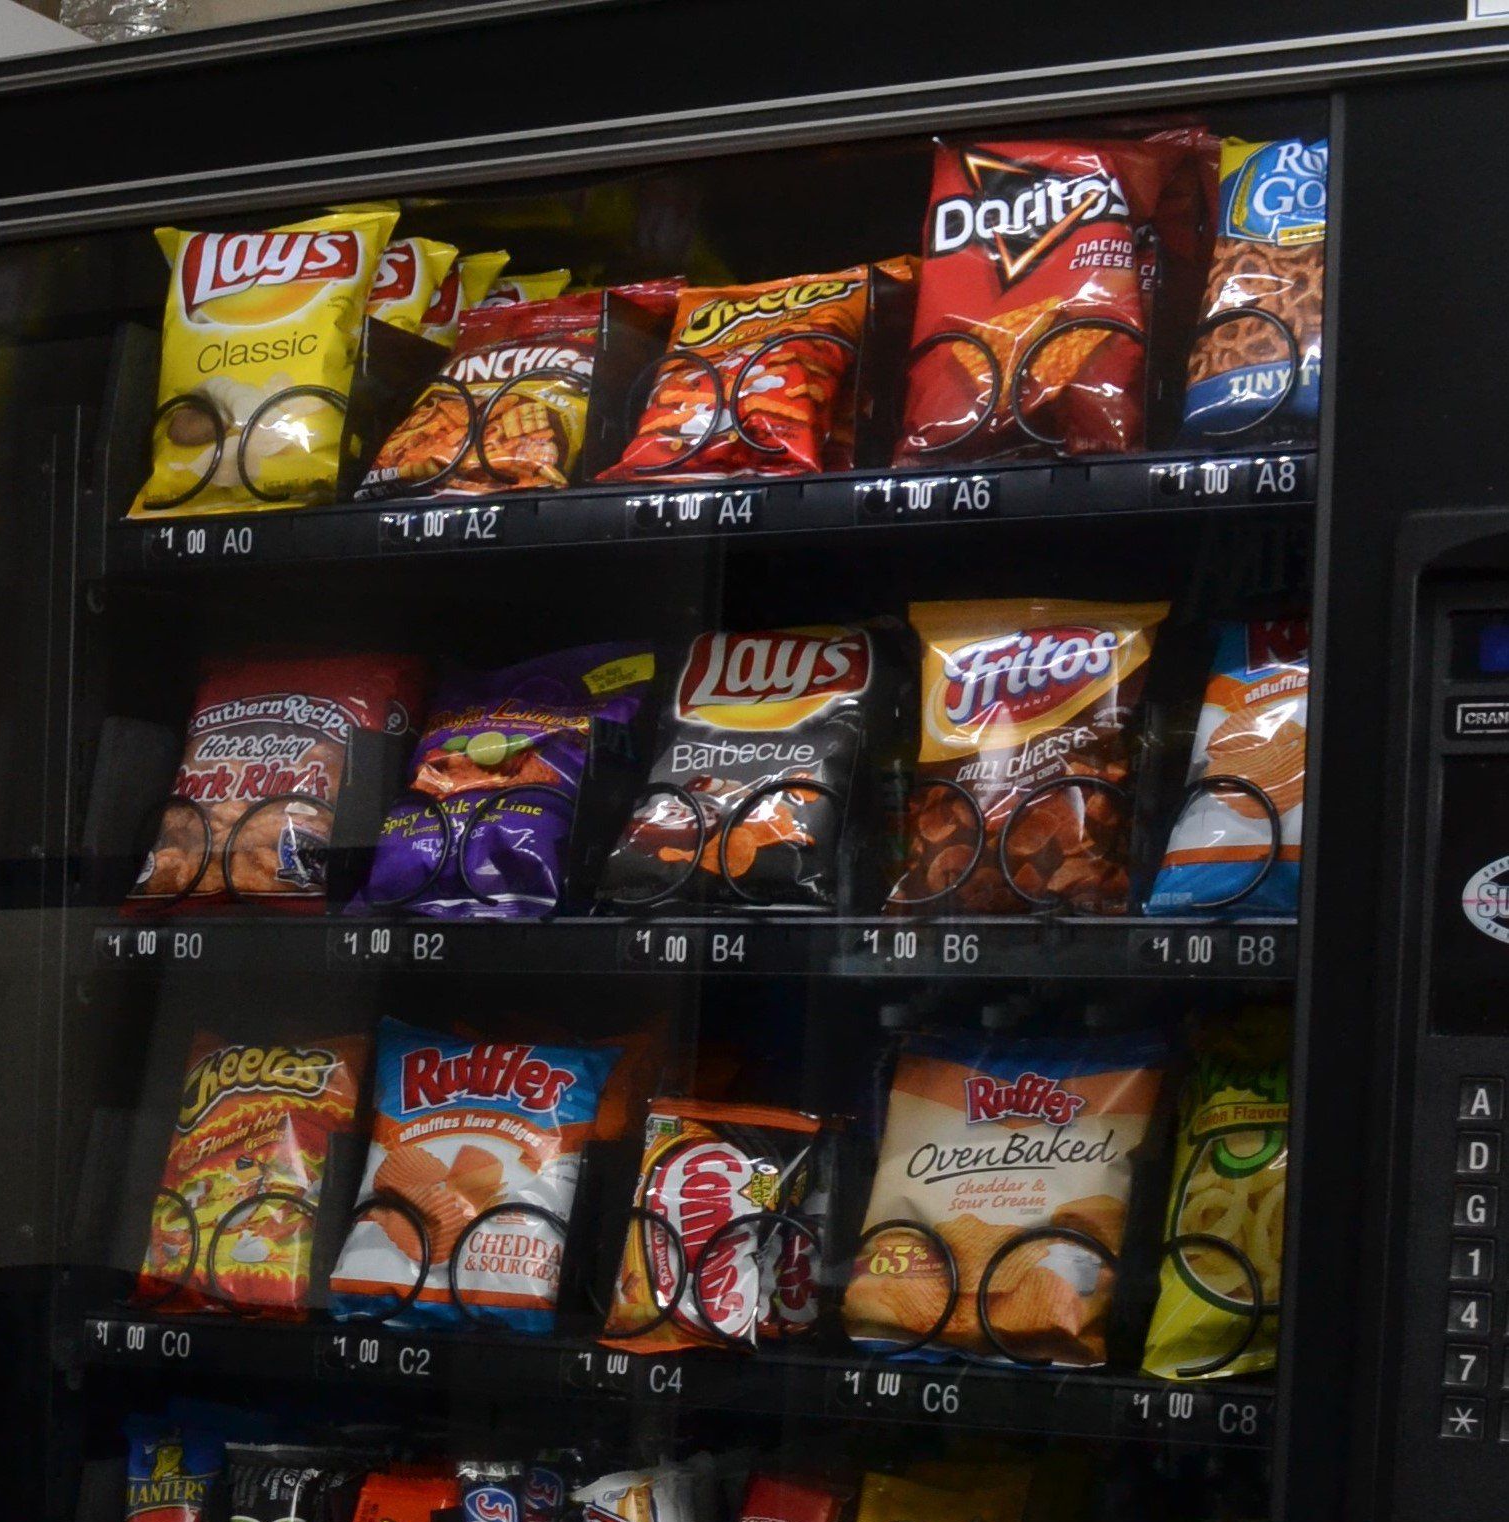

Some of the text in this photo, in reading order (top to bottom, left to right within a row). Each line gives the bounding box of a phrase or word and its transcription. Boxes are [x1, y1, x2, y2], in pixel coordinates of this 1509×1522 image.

[931, 175, 1130, 253] Doritos
[1068, 253, 1134, 271] CHEESE
[1075, 238, 1133, 257] NACHO
[185, 231, 353, 305] Lay's
[680, 280, 848, 345] Cheetos
[197, 331, 318, 374] Classic
[1228, 368, 1291, 396] TINY
[953, 477, 990, 510] A6
[1255, 462, 1296, 495] A8
[464, 511, 498, 540] A2
[718, 496, 753, 524] A4
[159, 526, 253, 557] $1.00 A0
[688, 633, 863, 706] Lay's
[944, 630, 1119, 723] Fritos
[283, 694, 351, 738] Recipe
[197, 735, 315, 762] Hot & Spicy
[671, 741, 815, 773] Barbecue
[955, 726, 1090, 783] CHILI CHEESE
[236, 762, 329, 801] Rinds
[495, 798, 544, 816] Lime
[107, 930, 202, 958] $1.00 B0
[343, 928, 445, 960] $1.00 B2
[636, 930, 745, 963] $1.00 B4
[862, 929, 980, 964] $1.00 B6
[1151, 935, 1275, 966] $1.00 B8
[402, 1043, 577, 1114] Ruffles
[964, 1072, 1087, 1126] Ruffles
[1470, 1087, 1492, 1117] A
[463, 1112, 496, 1129] Have
[906, 1126, 1119, 1179] Oven Baked
[1468, 1141, 1490, 1170] D
[955, 1177, 1047, 1196] Cheddar &
[1466, 1194, 1487, 1224] G
[469, 1230, 563, 1264] CHEDDA
[679, 1150, 751, 1323] Combos
[464, 1254, 521, 1275] & SOUR
[1468, 1248, 1481, 1277] 1
[1460, 1301, 1479, 1329] 4
[95, 1322, 192, 1358] $1.00 C0
[333, 1336, 431, 1376] $1.00 C2
[649, 1365, 683, 1394] C4
[1459, 1353, 1477, 1382] 7
[922, 1382, 960, 1415] C6
[1132, 1392, 1258, 1435] $1.00 C8
